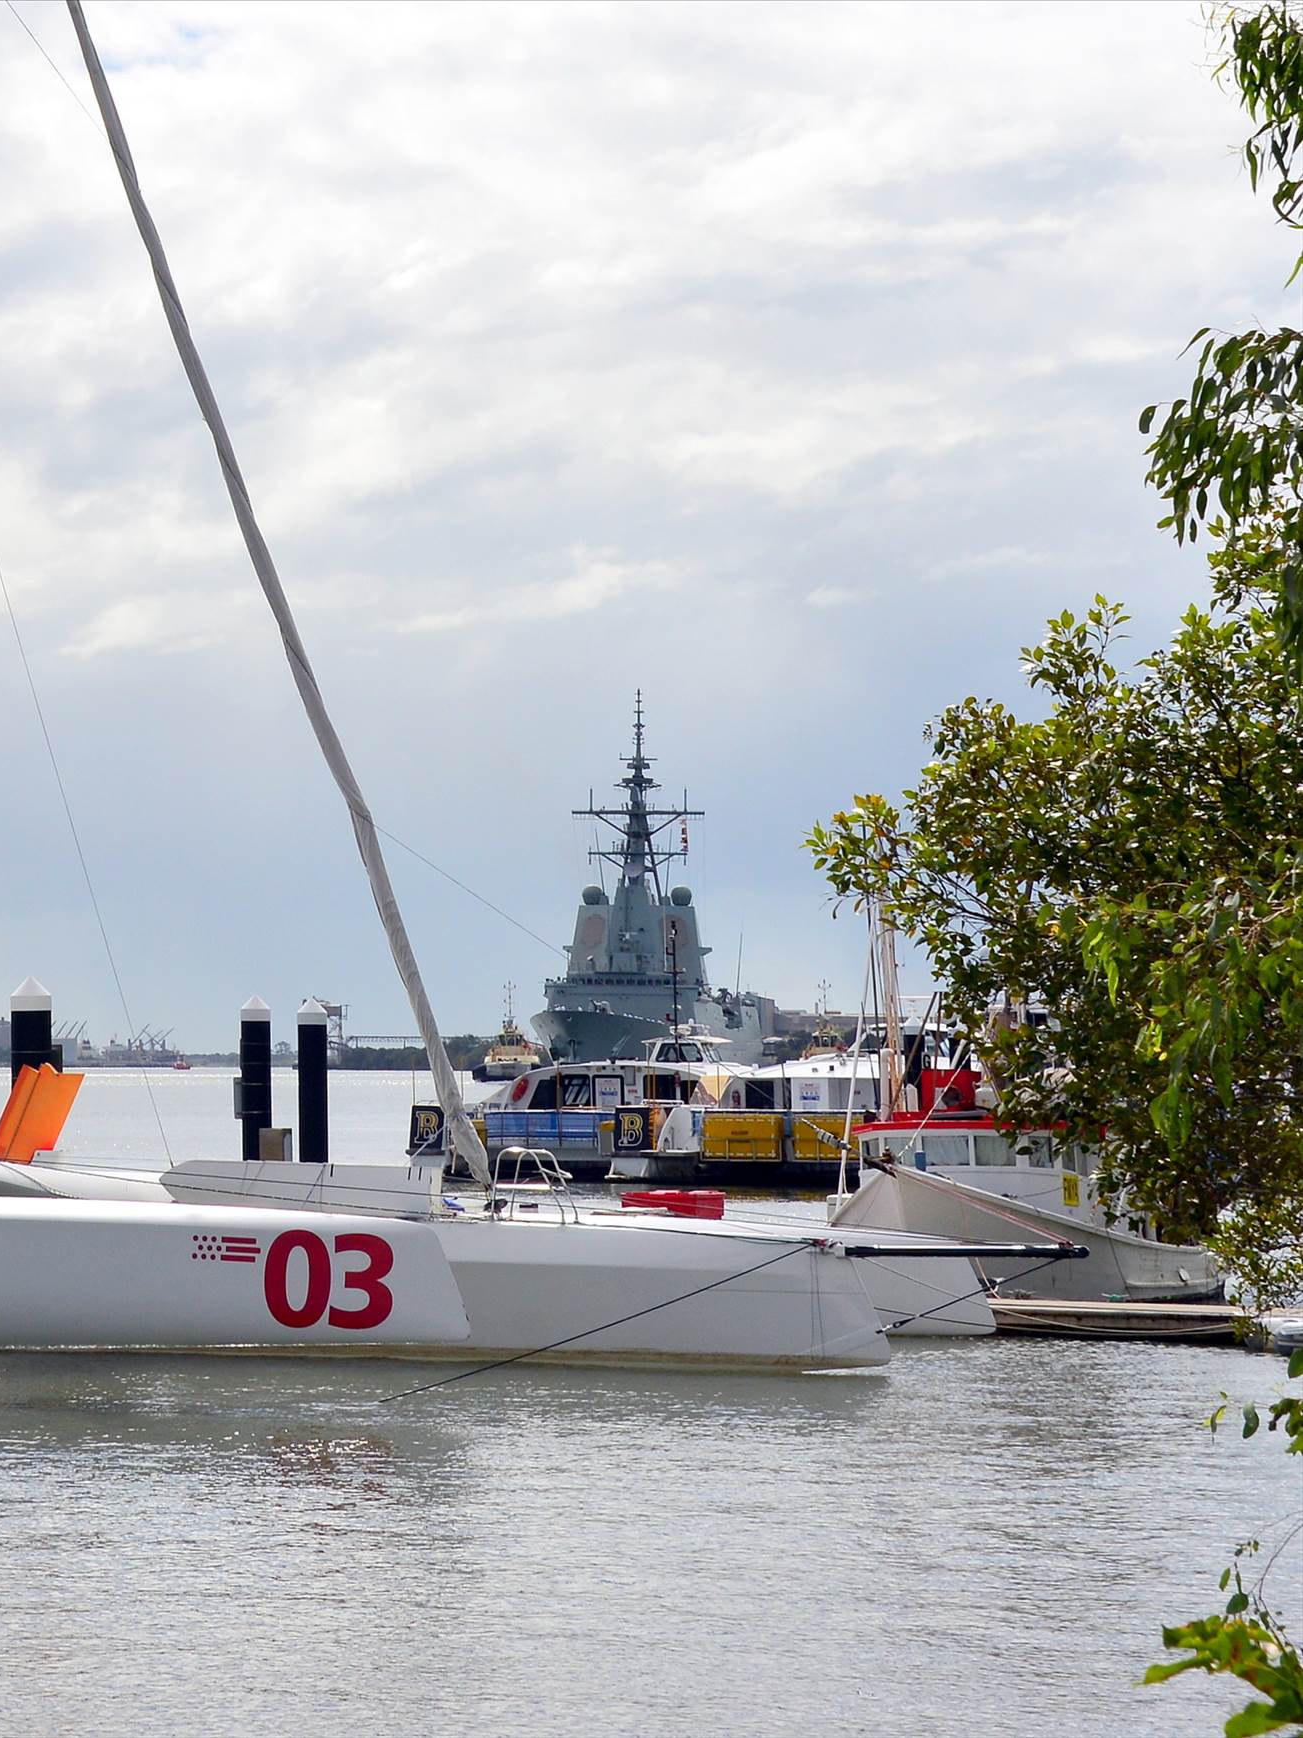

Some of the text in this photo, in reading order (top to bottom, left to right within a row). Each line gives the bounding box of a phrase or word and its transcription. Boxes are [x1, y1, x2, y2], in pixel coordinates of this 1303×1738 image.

[922, 1054, 932, 1069] G
[414, 1110, 439, 1144] B
[618, 1112, 643, 1147] B
[263, 1228, 395, 1331] 03
